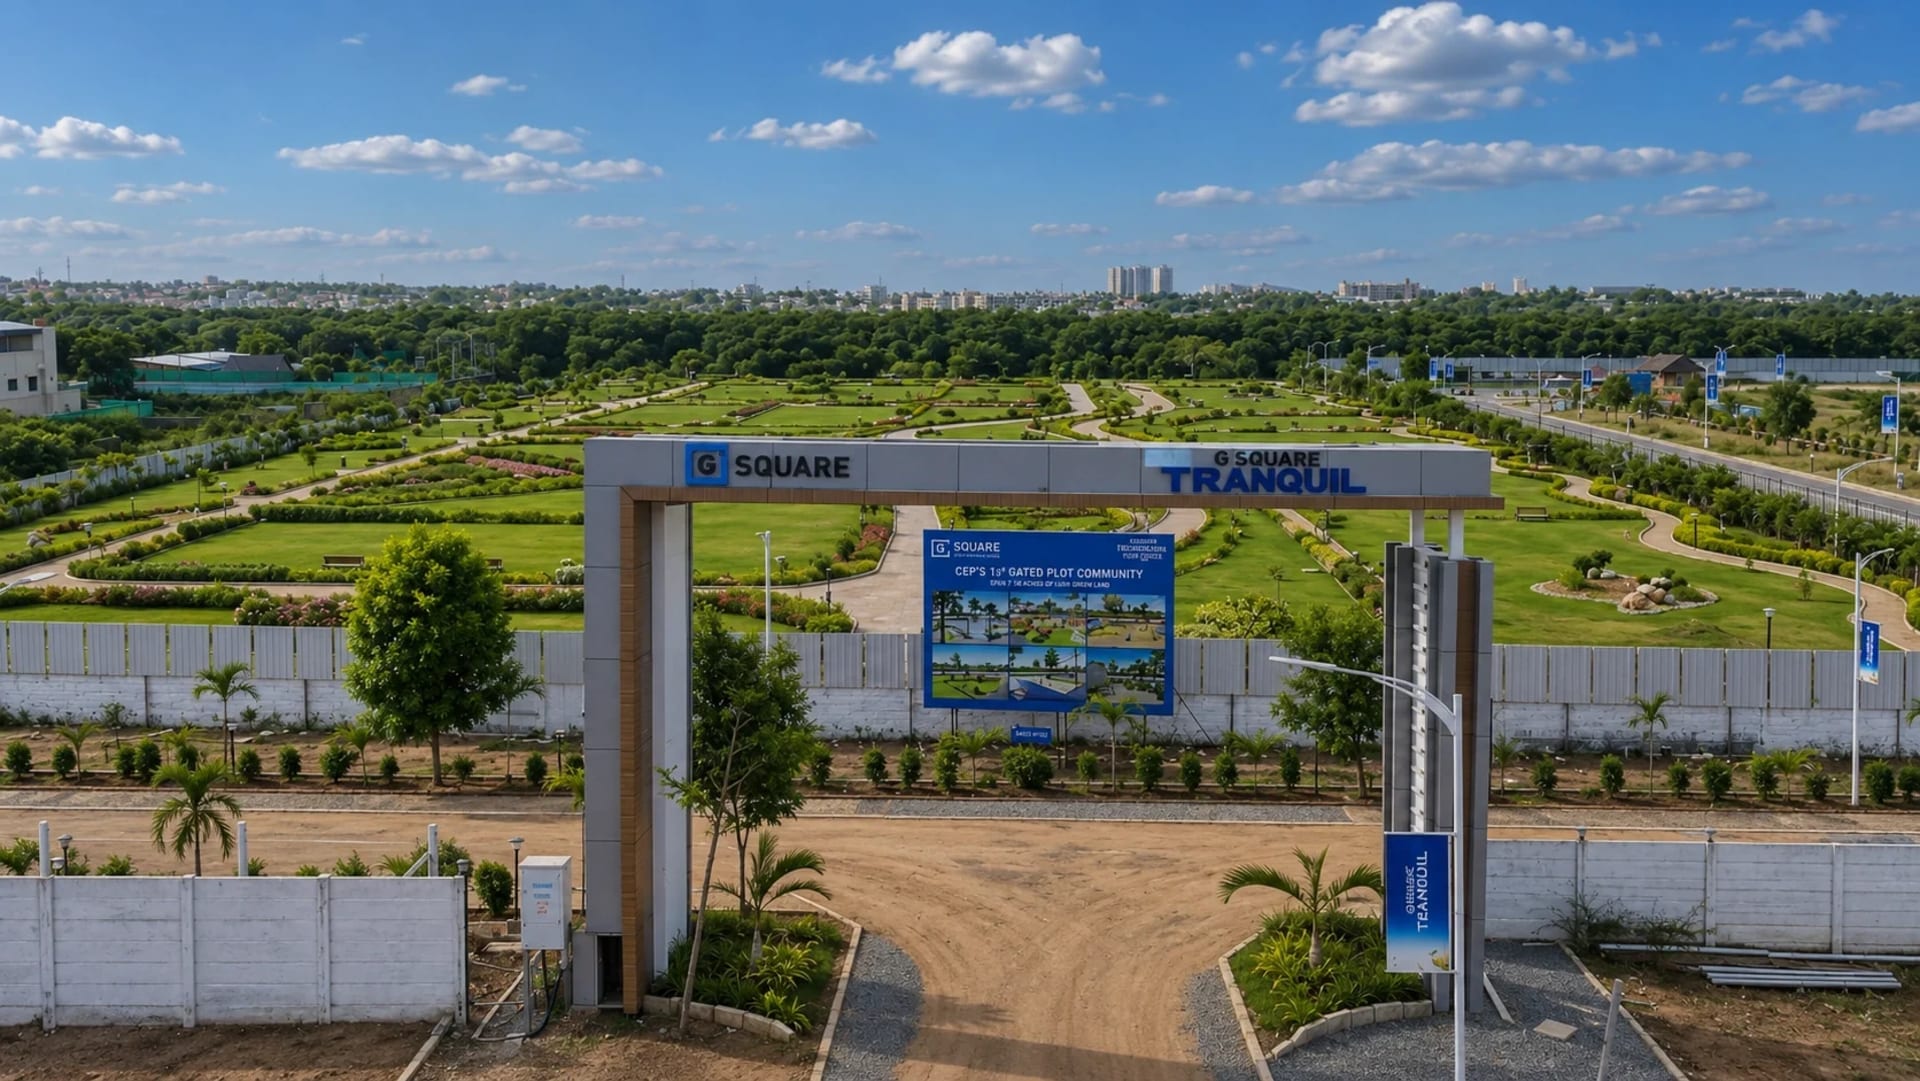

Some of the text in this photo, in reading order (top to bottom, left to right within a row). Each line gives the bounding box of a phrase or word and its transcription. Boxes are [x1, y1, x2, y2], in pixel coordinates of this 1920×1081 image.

[697, 454, 850, 478] G SQUARE
[1214, 450, 1321, 467] G SQUARE
[1161, 467, 1367, 494] TRANQUIL
[936, 541, 1001, 554] G SQUARE
[955, 566, 986, 577] CEP'S
[1008, 567, 1044, 578] GATED
[1047, 568, 1074, 578] PLOT
[1076, 568, 1144, 579] COMMUNITY
